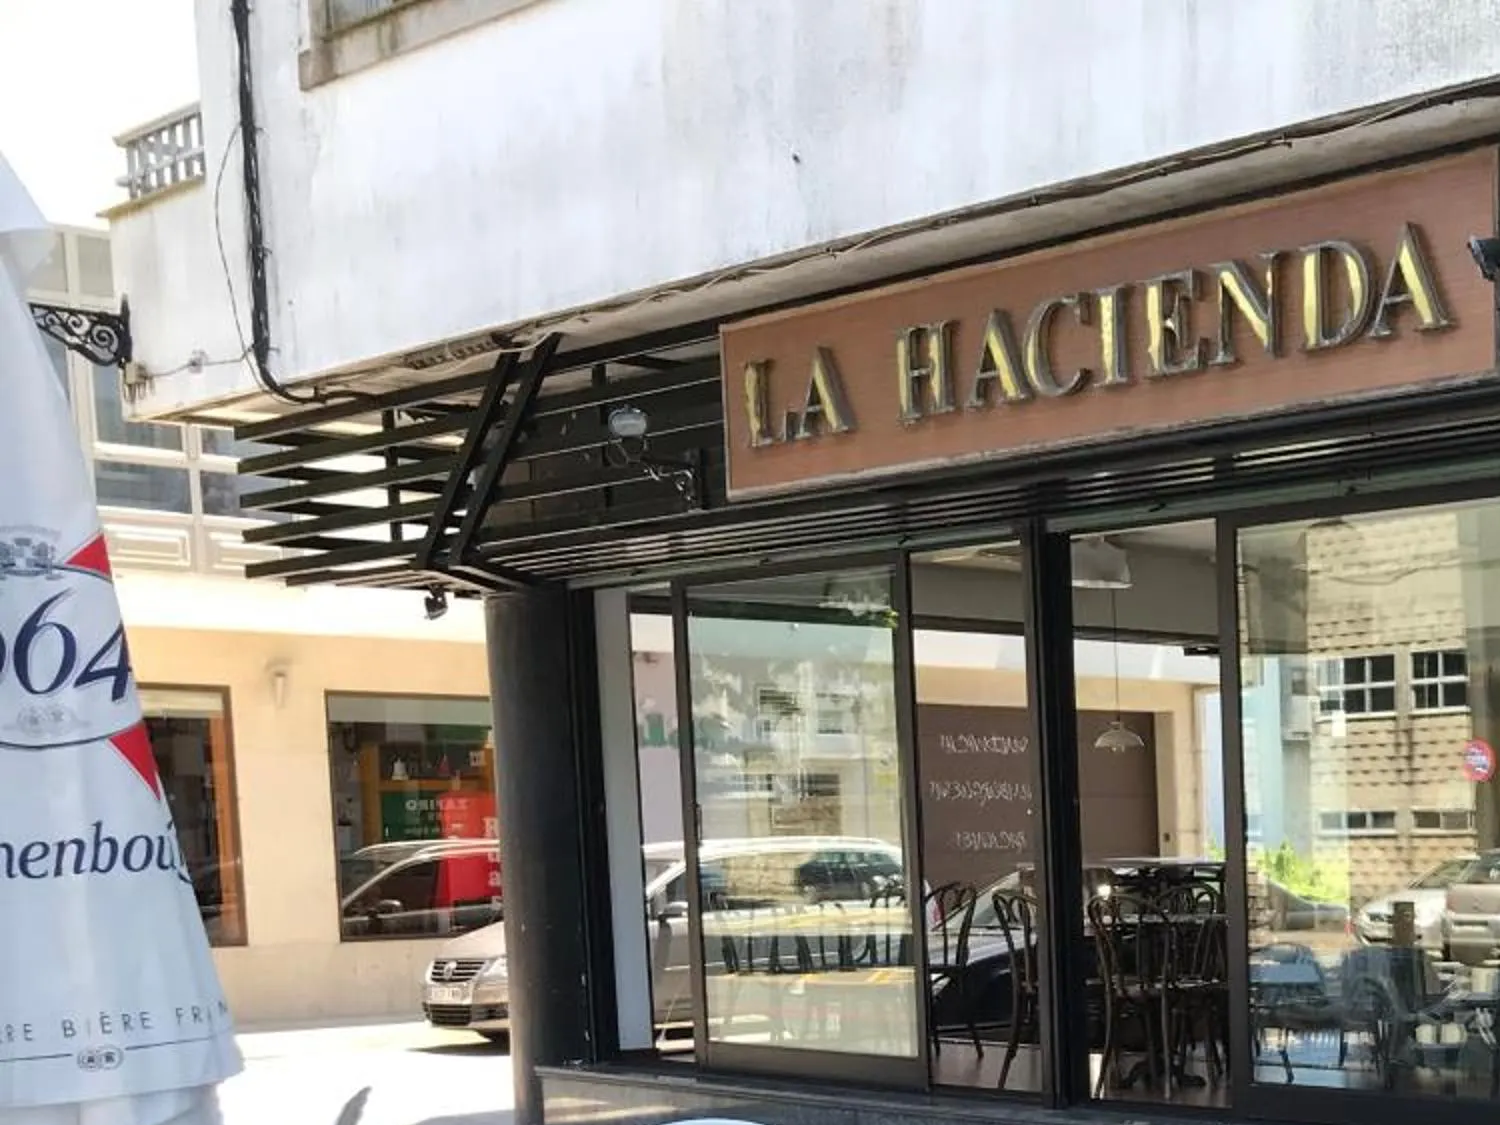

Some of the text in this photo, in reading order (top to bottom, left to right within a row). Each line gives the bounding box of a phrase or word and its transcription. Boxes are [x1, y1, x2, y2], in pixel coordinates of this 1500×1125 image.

[744, 221, 1457, 448] LA HACIENDA
[0, 587, 132, 702] 64
[61, 1011, 153, 1038] BIÈRE
